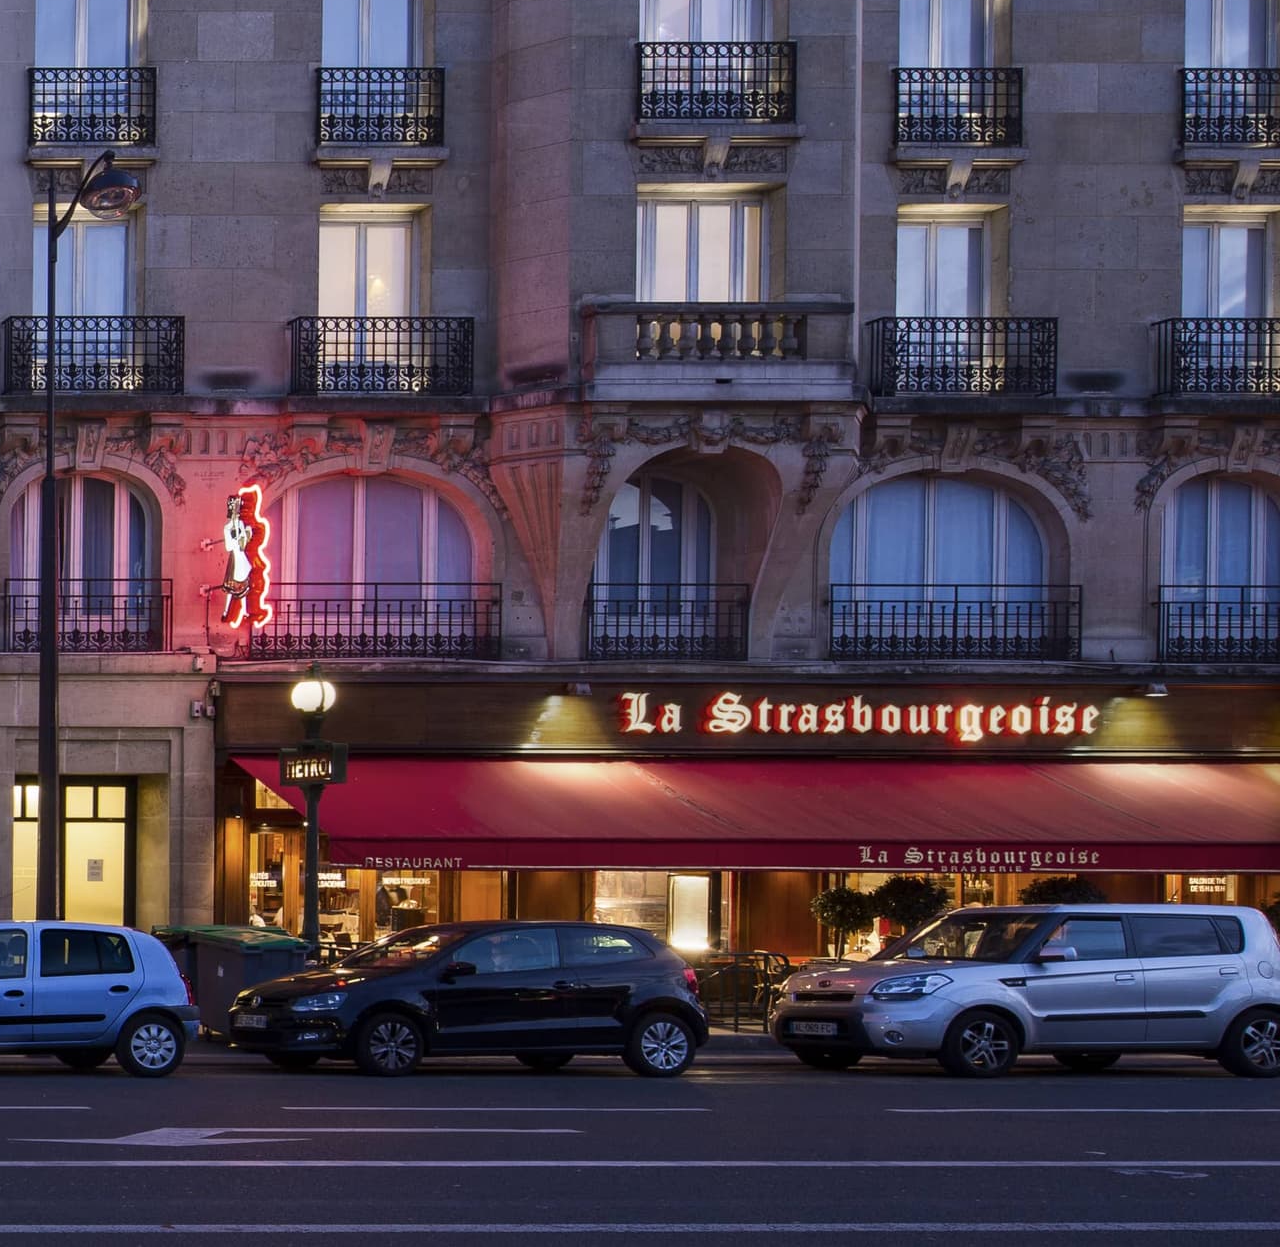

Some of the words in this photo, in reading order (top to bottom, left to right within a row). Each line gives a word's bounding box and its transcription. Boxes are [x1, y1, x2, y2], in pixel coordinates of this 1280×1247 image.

[620, 692, 683, 734] La
[704, 691, 1100, 742] Strasbourgeoise
[364, 856, 463, 869] RESTAURANT
[859, 846, 889, 864] La
[903, 847, 1100, 867] Strasbourgeoise
[941, 865, 1023, 873] BRASSERIE
